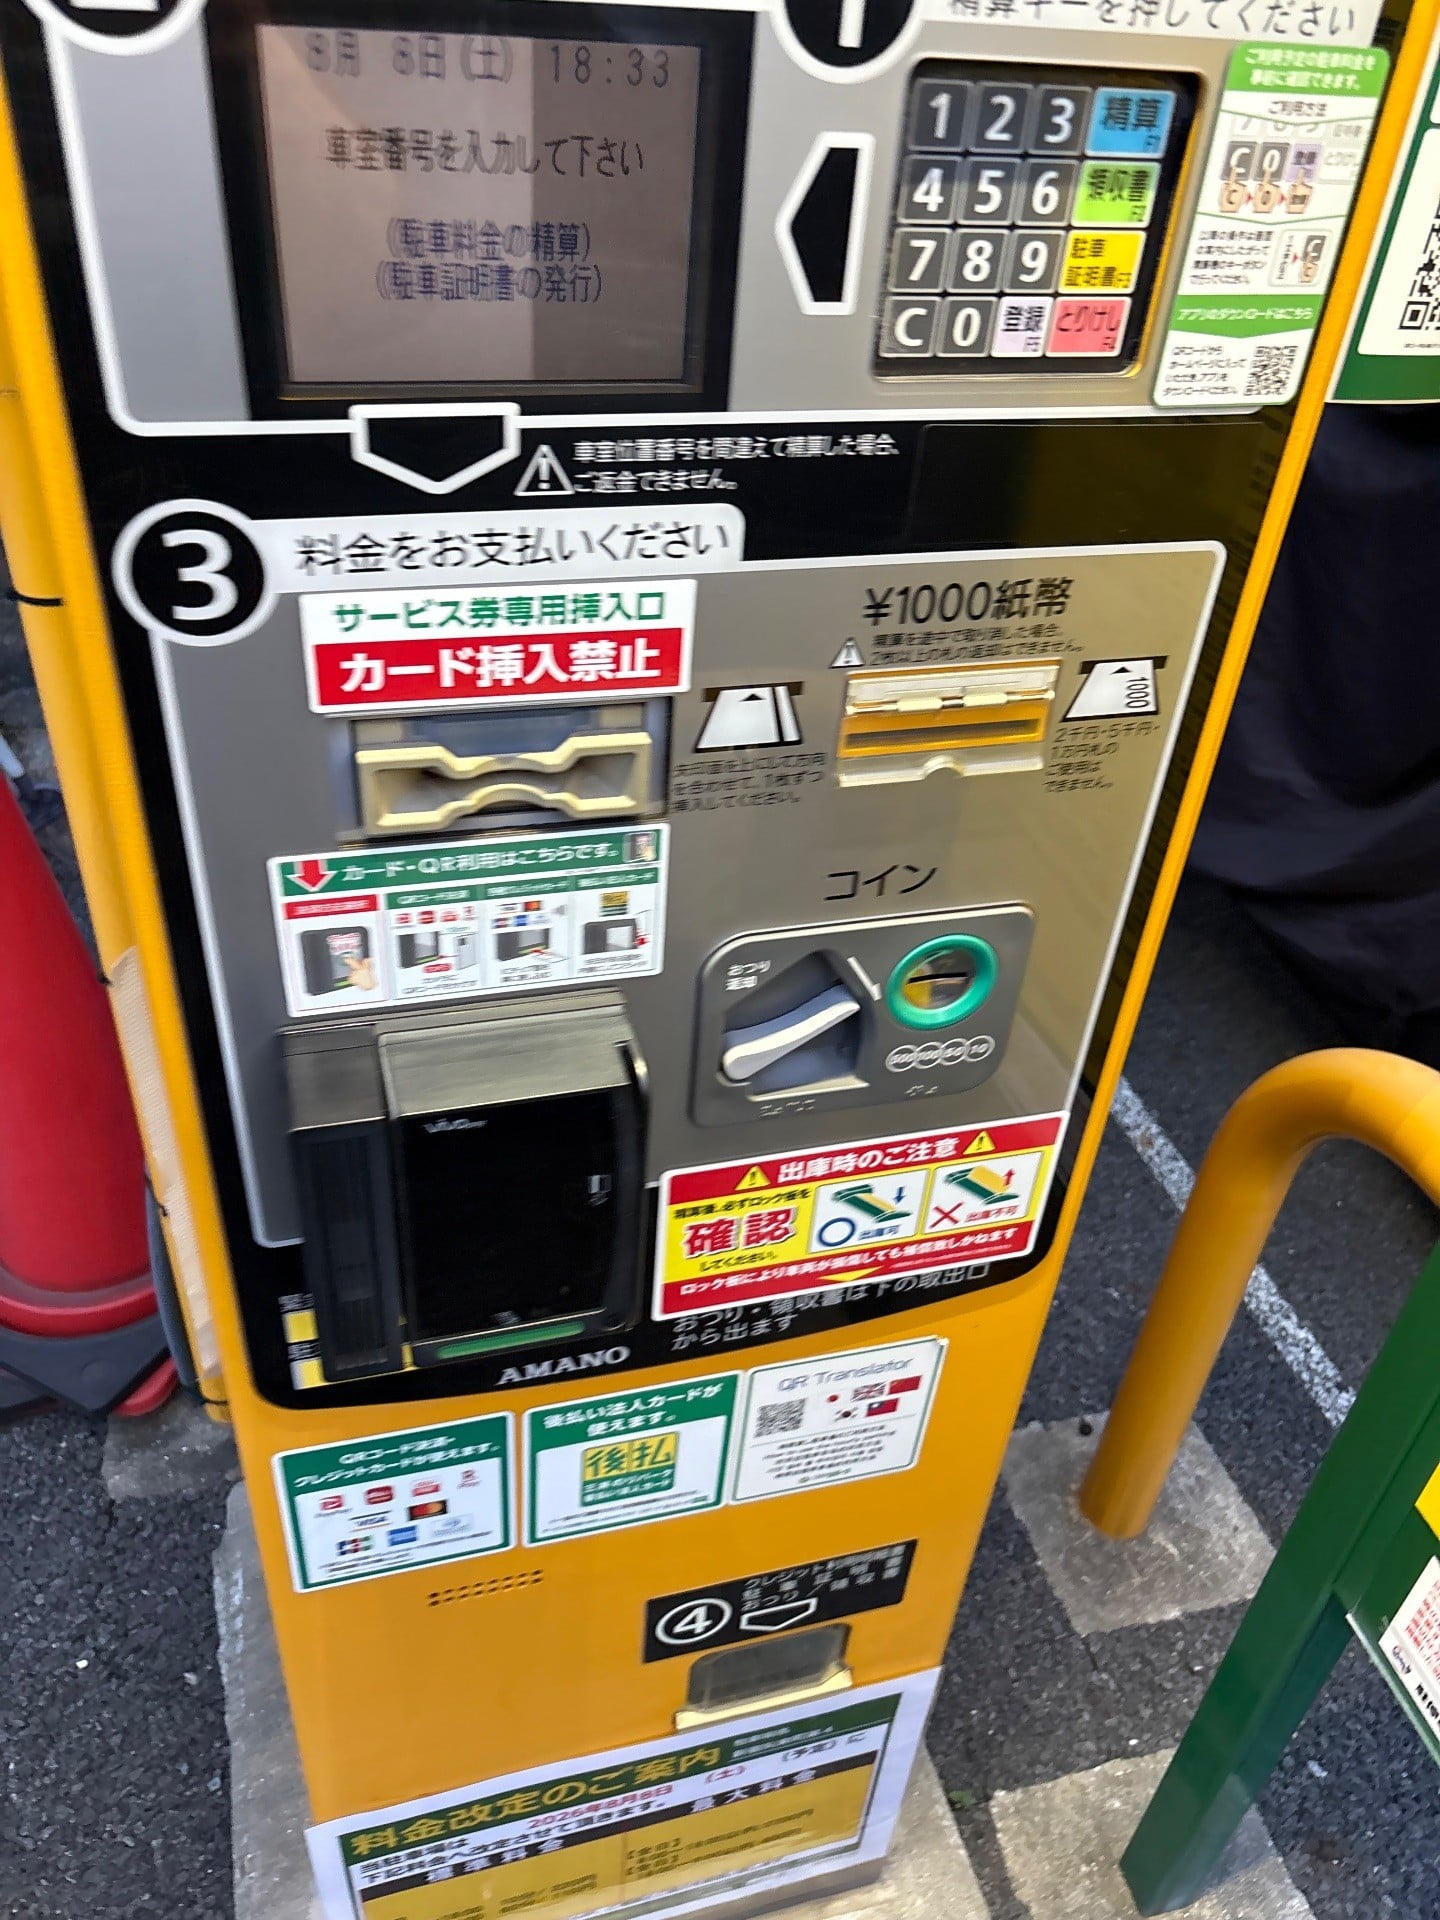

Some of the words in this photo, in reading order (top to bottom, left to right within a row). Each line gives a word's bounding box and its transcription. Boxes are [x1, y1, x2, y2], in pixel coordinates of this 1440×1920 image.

[548, 45, 670, 88] 18:33
[928, 93, 950, 138] 1
[983, 95, 1014, 141] 2
[1043, 97, 1075, 143] 3
[325, 127, 644, 178] 車室番号を入力して下さい
[910, 168, 945, 212] 4
[974, 171, 1003, 214] 5
[1030, 170, 1060, 215] 6
[909, 238, 939, 281] 7
[963, 239, 993, 283] 8
[1018, 240, 1049, 283] 9
[895, 307, 926, 348] C
[1055, 305, 1121, 333] とりけし
[295, 520, 730, 575] 料金をお支払いください
[161, 529, 239, 621] 3
[334, 591, 667, 633] サービス券専用挿入口
[863, 577, 1075, 627] ¥1000紙幣
[340, 640, 661, 693] カード挿入禁止
[1125, 676, 1150, 709] 1000
[823, 864, 938, 901] コイン
[726, 959, 772, 977] おつり
[776, 1136, 961, 1184] 出庫時のご注意
[684, 1207, 798, 1259] 確認
[857, 1225, 900, 1241] 出庫可
[964, 1204, 1020, 1223] 出庫不可
[671, 1313, 799, 1352] から出ます
[494, 1345, 632, 1387] AMANO
[778, 1374, 810, 1392] QR
[814, 1357, 914, 1385] Translator
[543, 1382, 724, 1430] 後払い法人カードが
[588, 1410, 677, 1437] 使えます。
[585, 1435, 672, 1479] 後払
[672, 1606, 714, 1635] 4
[350, 1746, 721, 1856] 料金改定のご案内
[529, 1784, 674, 1830] 2026年8月8日
